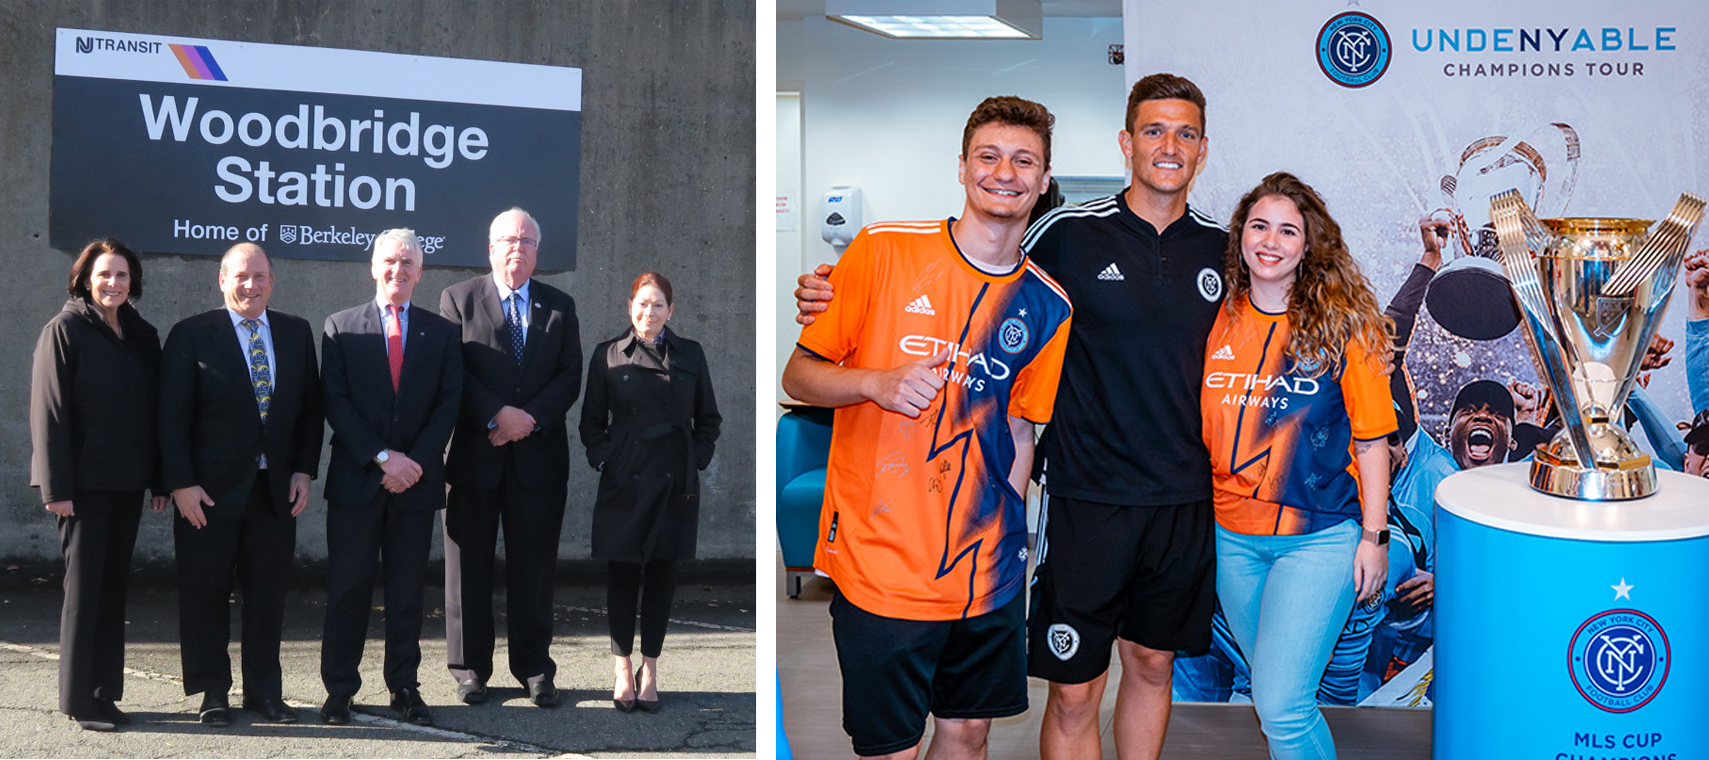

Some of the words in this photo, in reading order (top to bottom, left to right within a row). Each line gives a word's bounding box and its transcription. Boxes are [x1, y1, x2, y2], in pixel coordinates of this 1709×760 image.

[95, 37, 163, 55] TRANSIT
[1411, 27, 1677, 53] UNDENYABLE
[1443, 63, 1575, 77] CHAMPIONS
[1586, 62, 1645, 76] TOUR
[139, 93, 489, 169] Woodbridge
[214, 155, 416, 212] Station
[173, 219, 239, 241] Home
[245, 223, 269, 242] of
[299, 225, 376, 252] Berkeley
[899, 334, 1011, 380] ETIHAD
[1205, 371, 1320, 396] ETIHAD
[1221, 393, 1289, 410] AIRWAYS
[1586, 618, 1607, 635] NEW
[1608, 615, 1635, 624] YORK
[1635, 618, 1654, 634] CITY
[1585, 684, 1632, 707] FOOTBALL
[1632, 684, 1654, 703] CLUB
[1574, 731, 1616, 749] MLS
[1622, 732, 1663, 749] CUP
